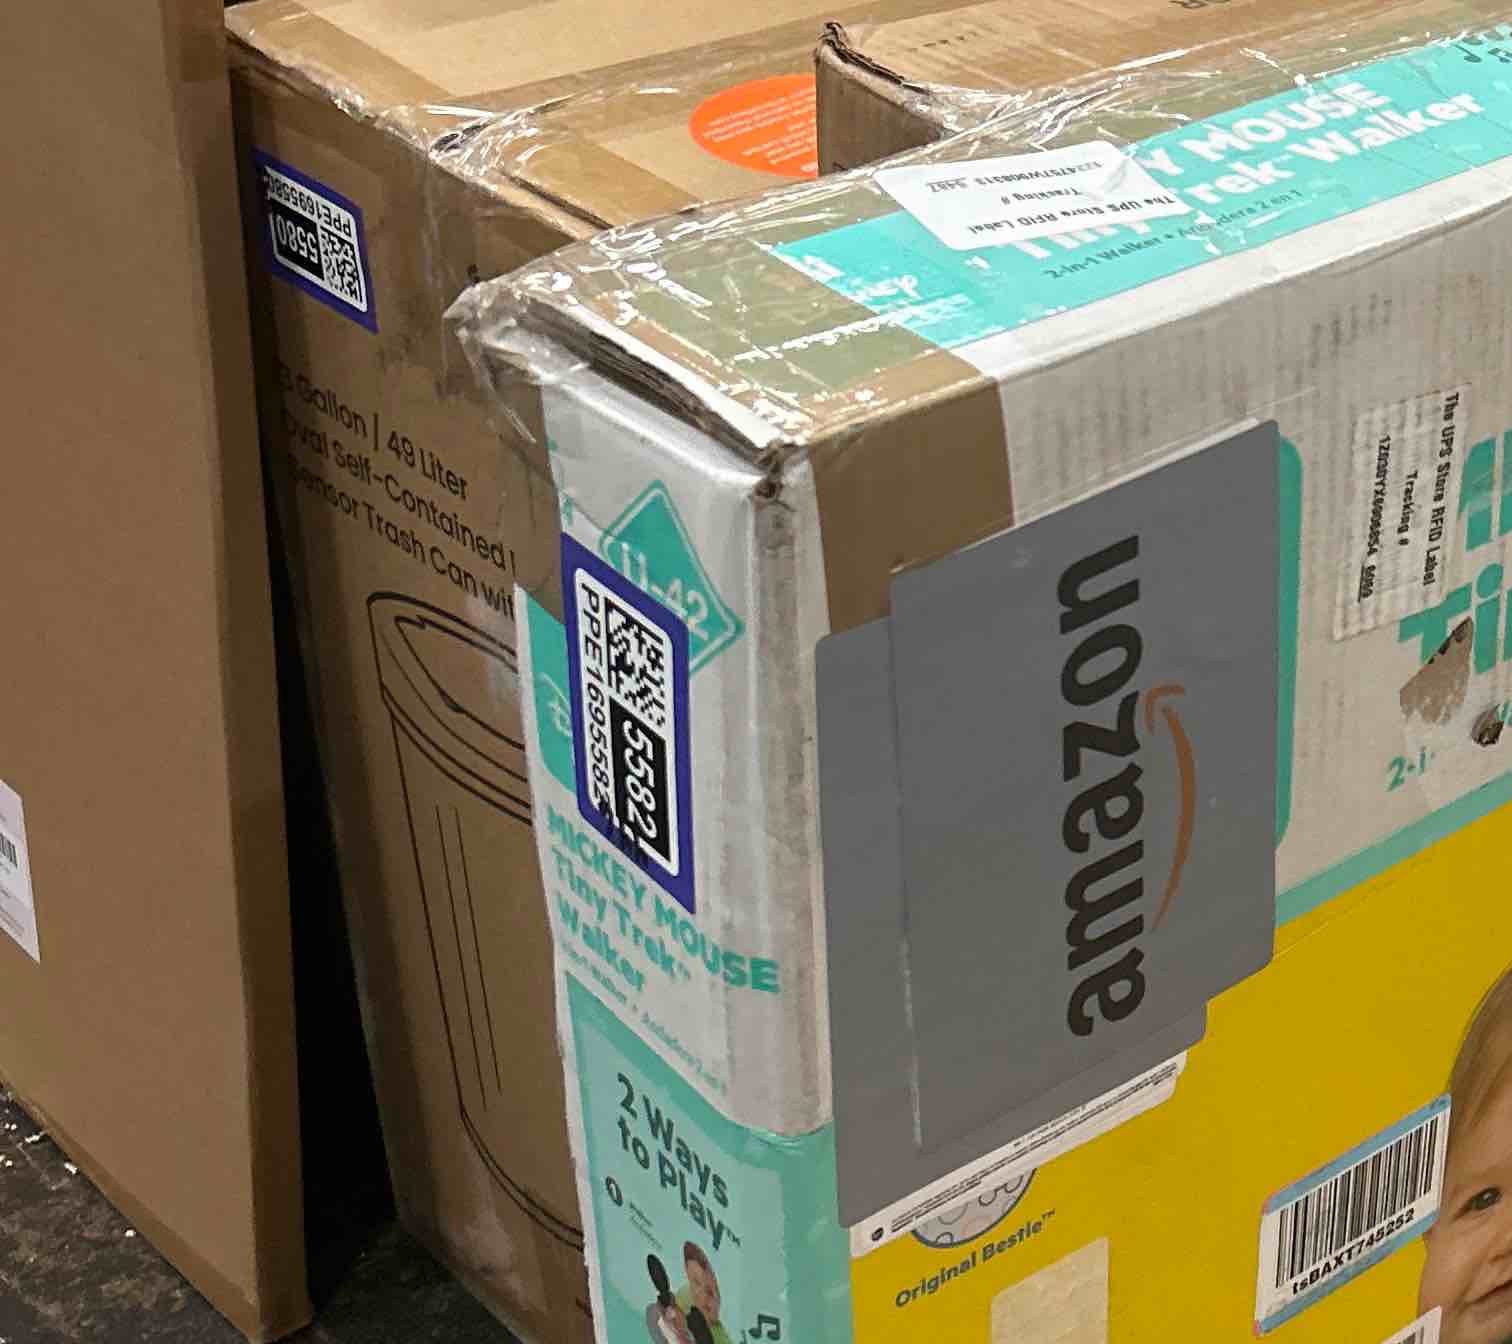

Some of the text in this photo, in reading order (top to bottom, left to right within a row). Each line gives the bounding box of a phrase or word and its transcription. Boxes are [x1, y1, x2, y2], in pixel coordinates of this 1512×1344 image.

[1181, 82, 1390, 161] MOUSE
[1188, 154, 1295, 204] rek
[1287, 93, 1486, 163] Walker
[277, 215, 320, 265] 5580
[1100, 234, 1162, 258] Walker
[387, 430, 416, 469] 49
[420, 458, 469, 502] Liter
[1397, 469, 1419, 536] Tracking
[334, 439, 506, 572] Self-Contained
[1428, 506, 1446, 543] RFID
[363, 500, 426, 562] Trash
[430, 545, 479, 601] Can
[480, 579, 516, 620] wit
[1423, 545, 1441, 588] Label
[623, 720, 658, 840] 5582
[1057, 534, 1146, 1037] amazon
[547, 802, 647, 911] MICKEY
[653, 894, 783, 993] MOUSE
[616, 1115, 650, 1170] to
[617, 1072, 730, 1209] 2 Ways
[894, 1249, 978, 1308] Original
